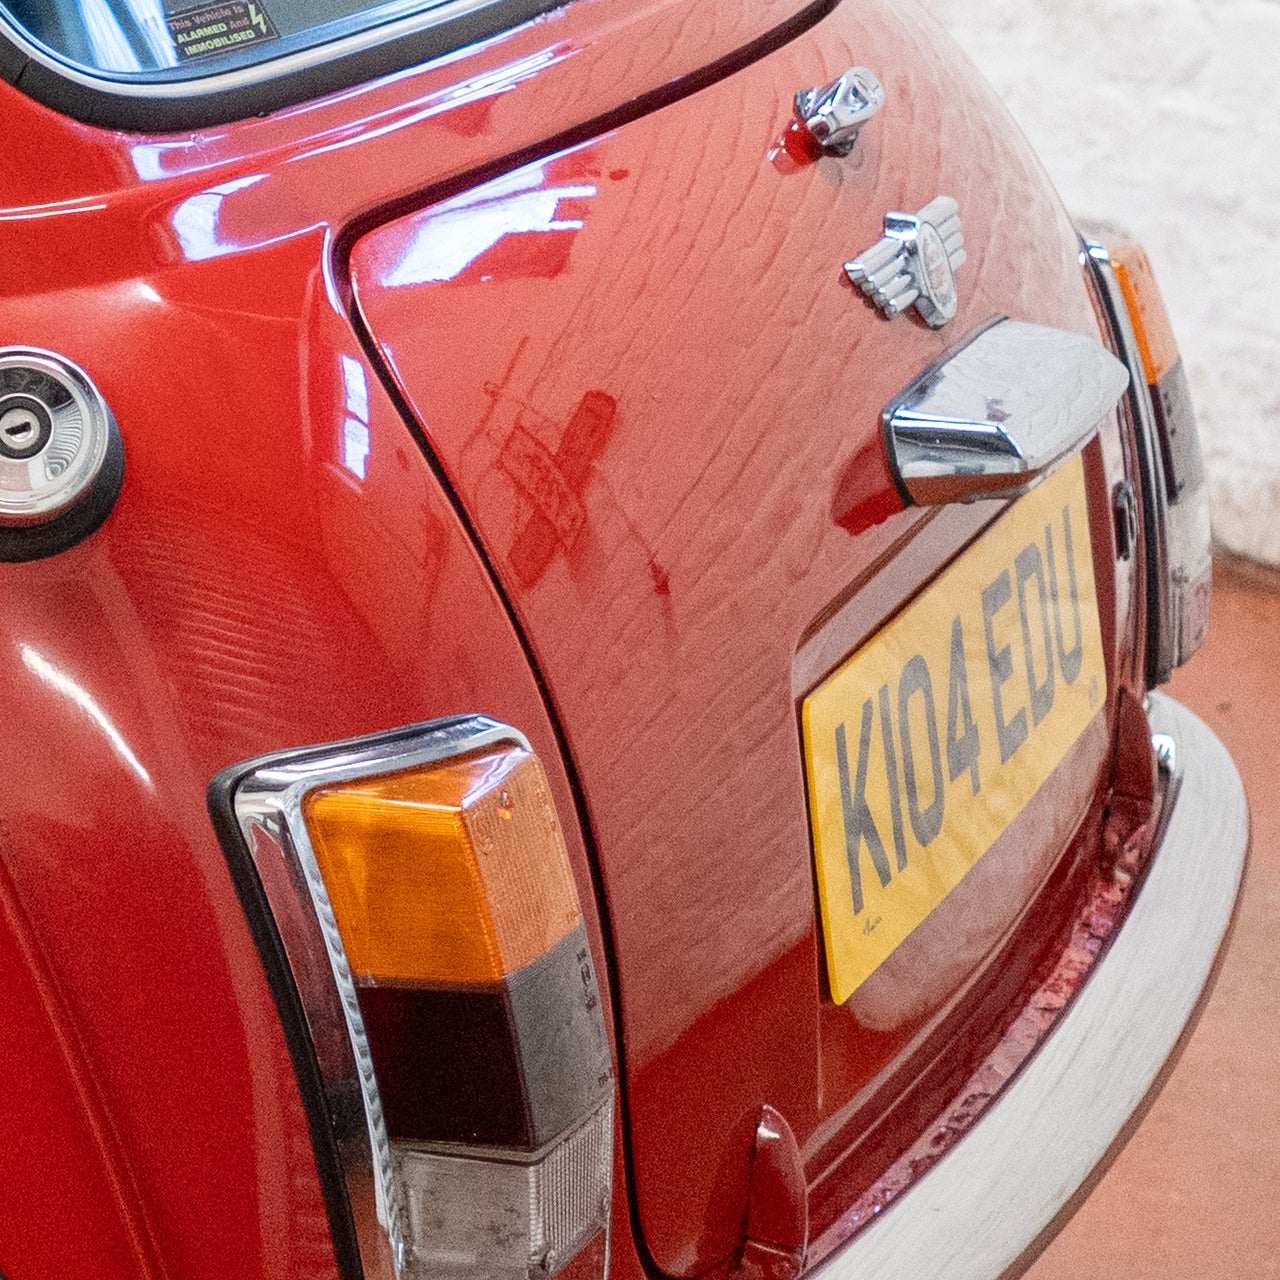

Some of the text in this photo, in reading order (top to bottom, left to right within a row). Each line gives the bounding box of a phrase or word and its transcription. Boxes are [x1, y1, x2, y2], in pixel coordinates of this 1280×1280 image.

[192, 9, 233, 24] Vehicle
[177, 17, 250, 44] ALARMED And
[184, 29, 255, 56] IMMOBILISED
[834, 505, 1083, 915] K104 EDU
